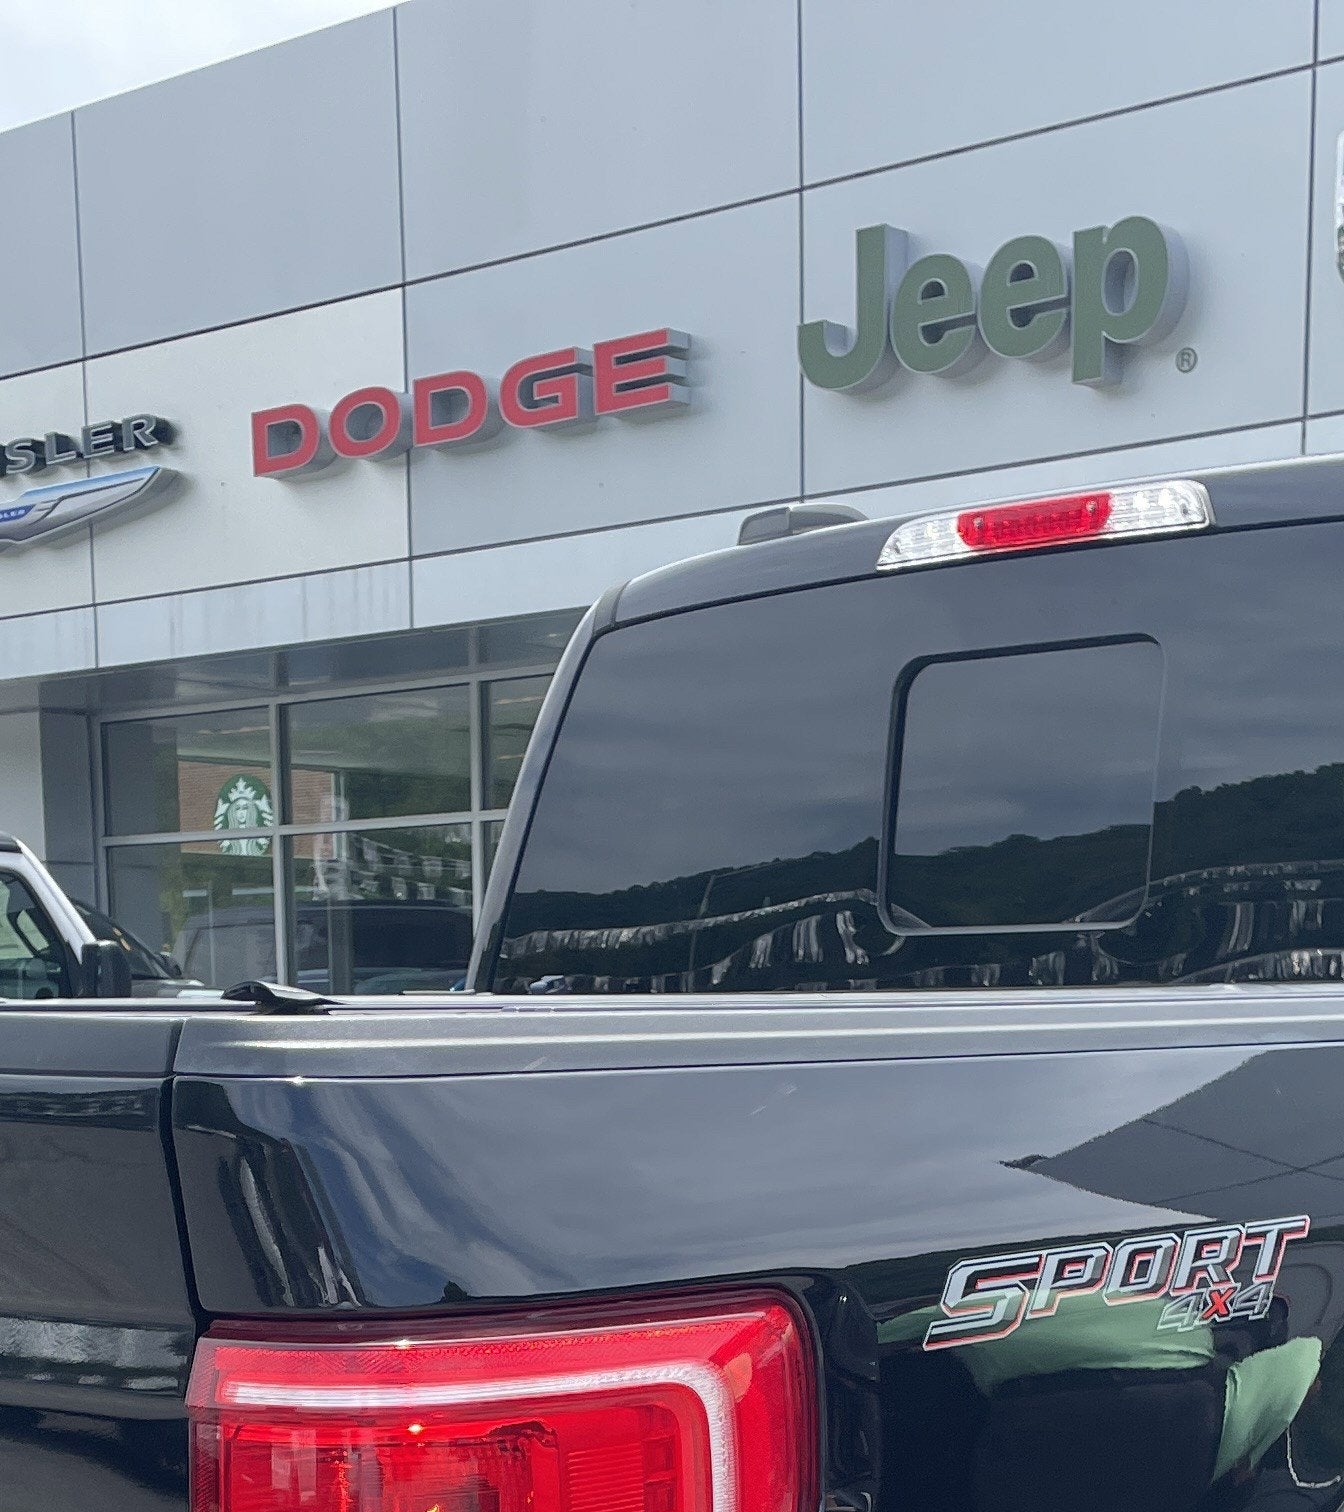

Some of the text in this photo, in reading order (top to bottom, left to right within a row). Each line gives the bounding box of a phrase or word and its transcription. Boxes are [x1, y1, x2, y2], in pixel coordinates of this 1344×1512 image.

[797, 214, 1172, 390] Jeep
[251, 327, 674, 478] DODGE
[923, 1214, 1311, 1352] SPORT
